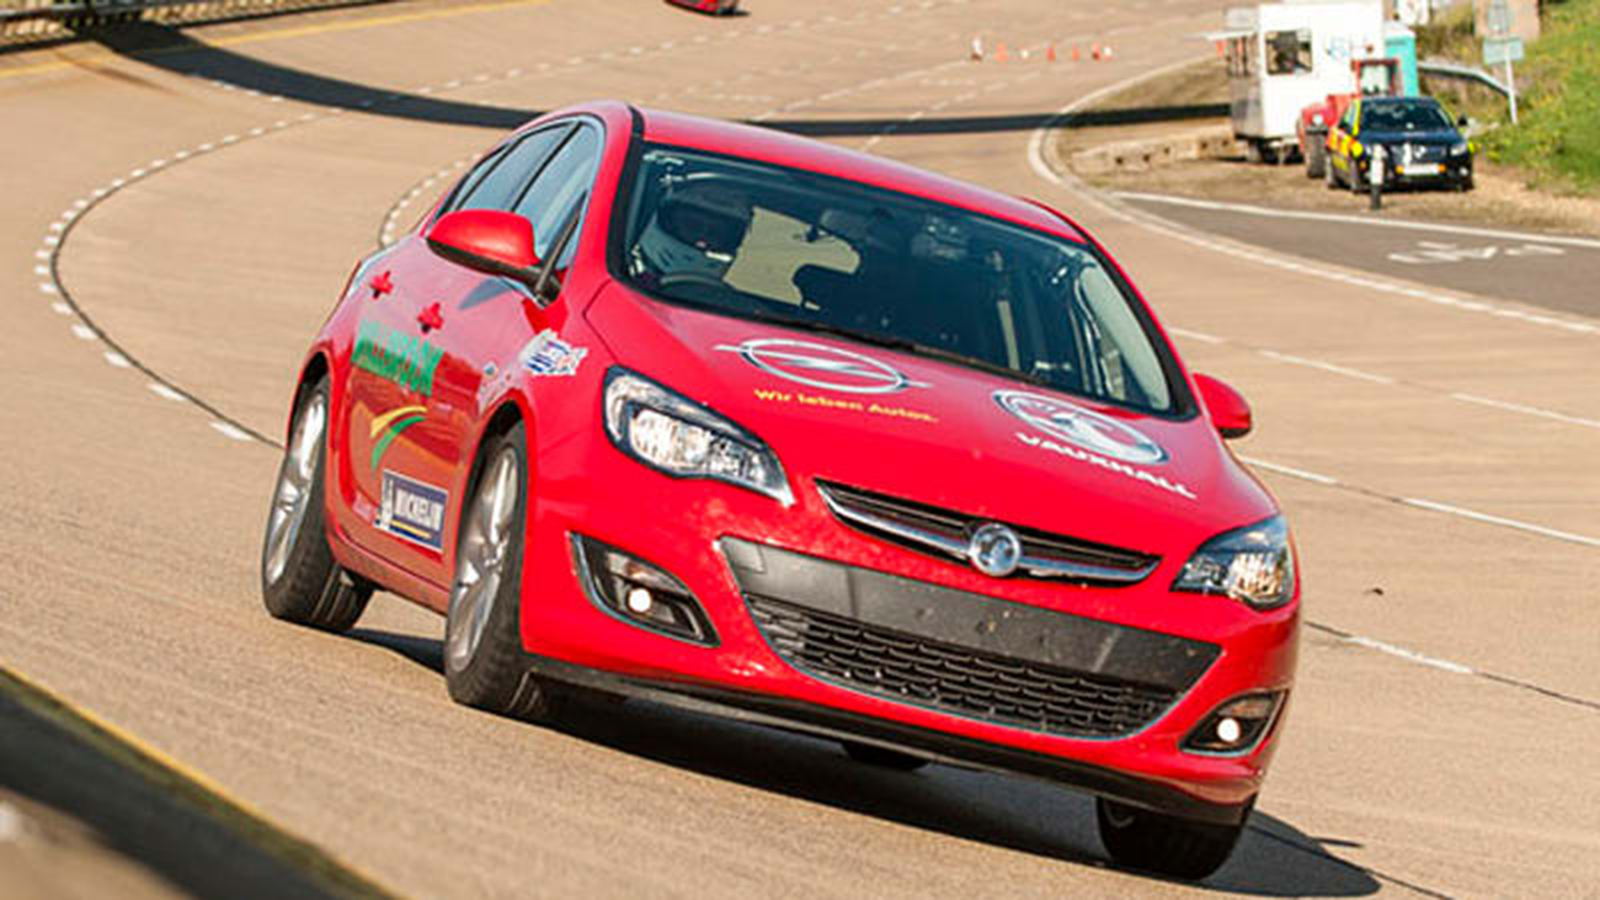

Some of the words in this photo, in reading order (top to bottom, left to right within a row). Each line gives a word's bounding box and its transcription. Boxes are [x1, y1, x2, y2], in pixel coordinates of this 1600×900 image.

[754, 388, 792, 402] Wir
[797, 393, 863, 412] leben
[1015, 432, 1197, 499] VAUXHALL
